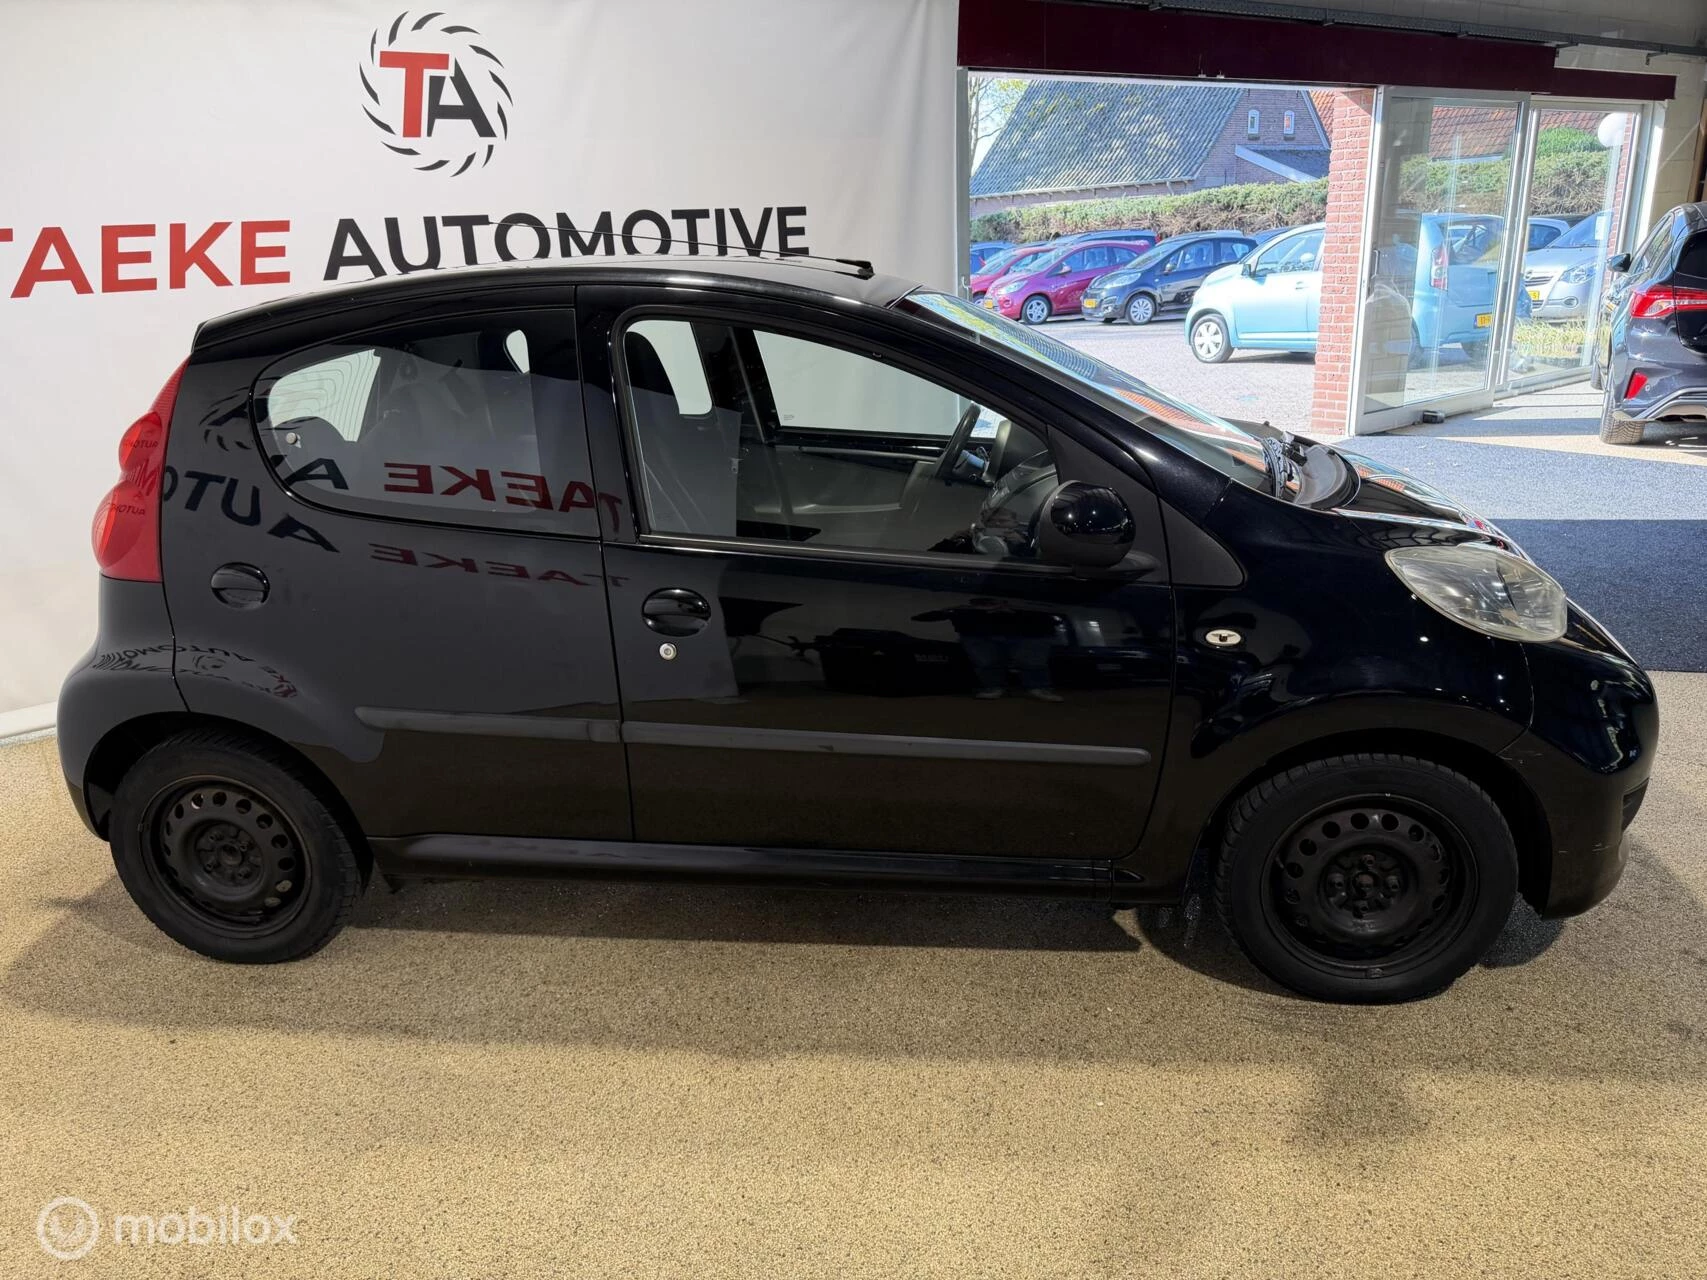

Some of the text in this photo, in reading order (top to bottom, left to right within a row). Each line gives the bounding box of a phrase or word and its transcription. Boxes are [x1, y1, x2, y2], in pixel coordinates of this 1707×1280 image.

[379, 50, 498, 138] TA
[0, 205, 809, 299] AEKE AUTOMOTIVE
